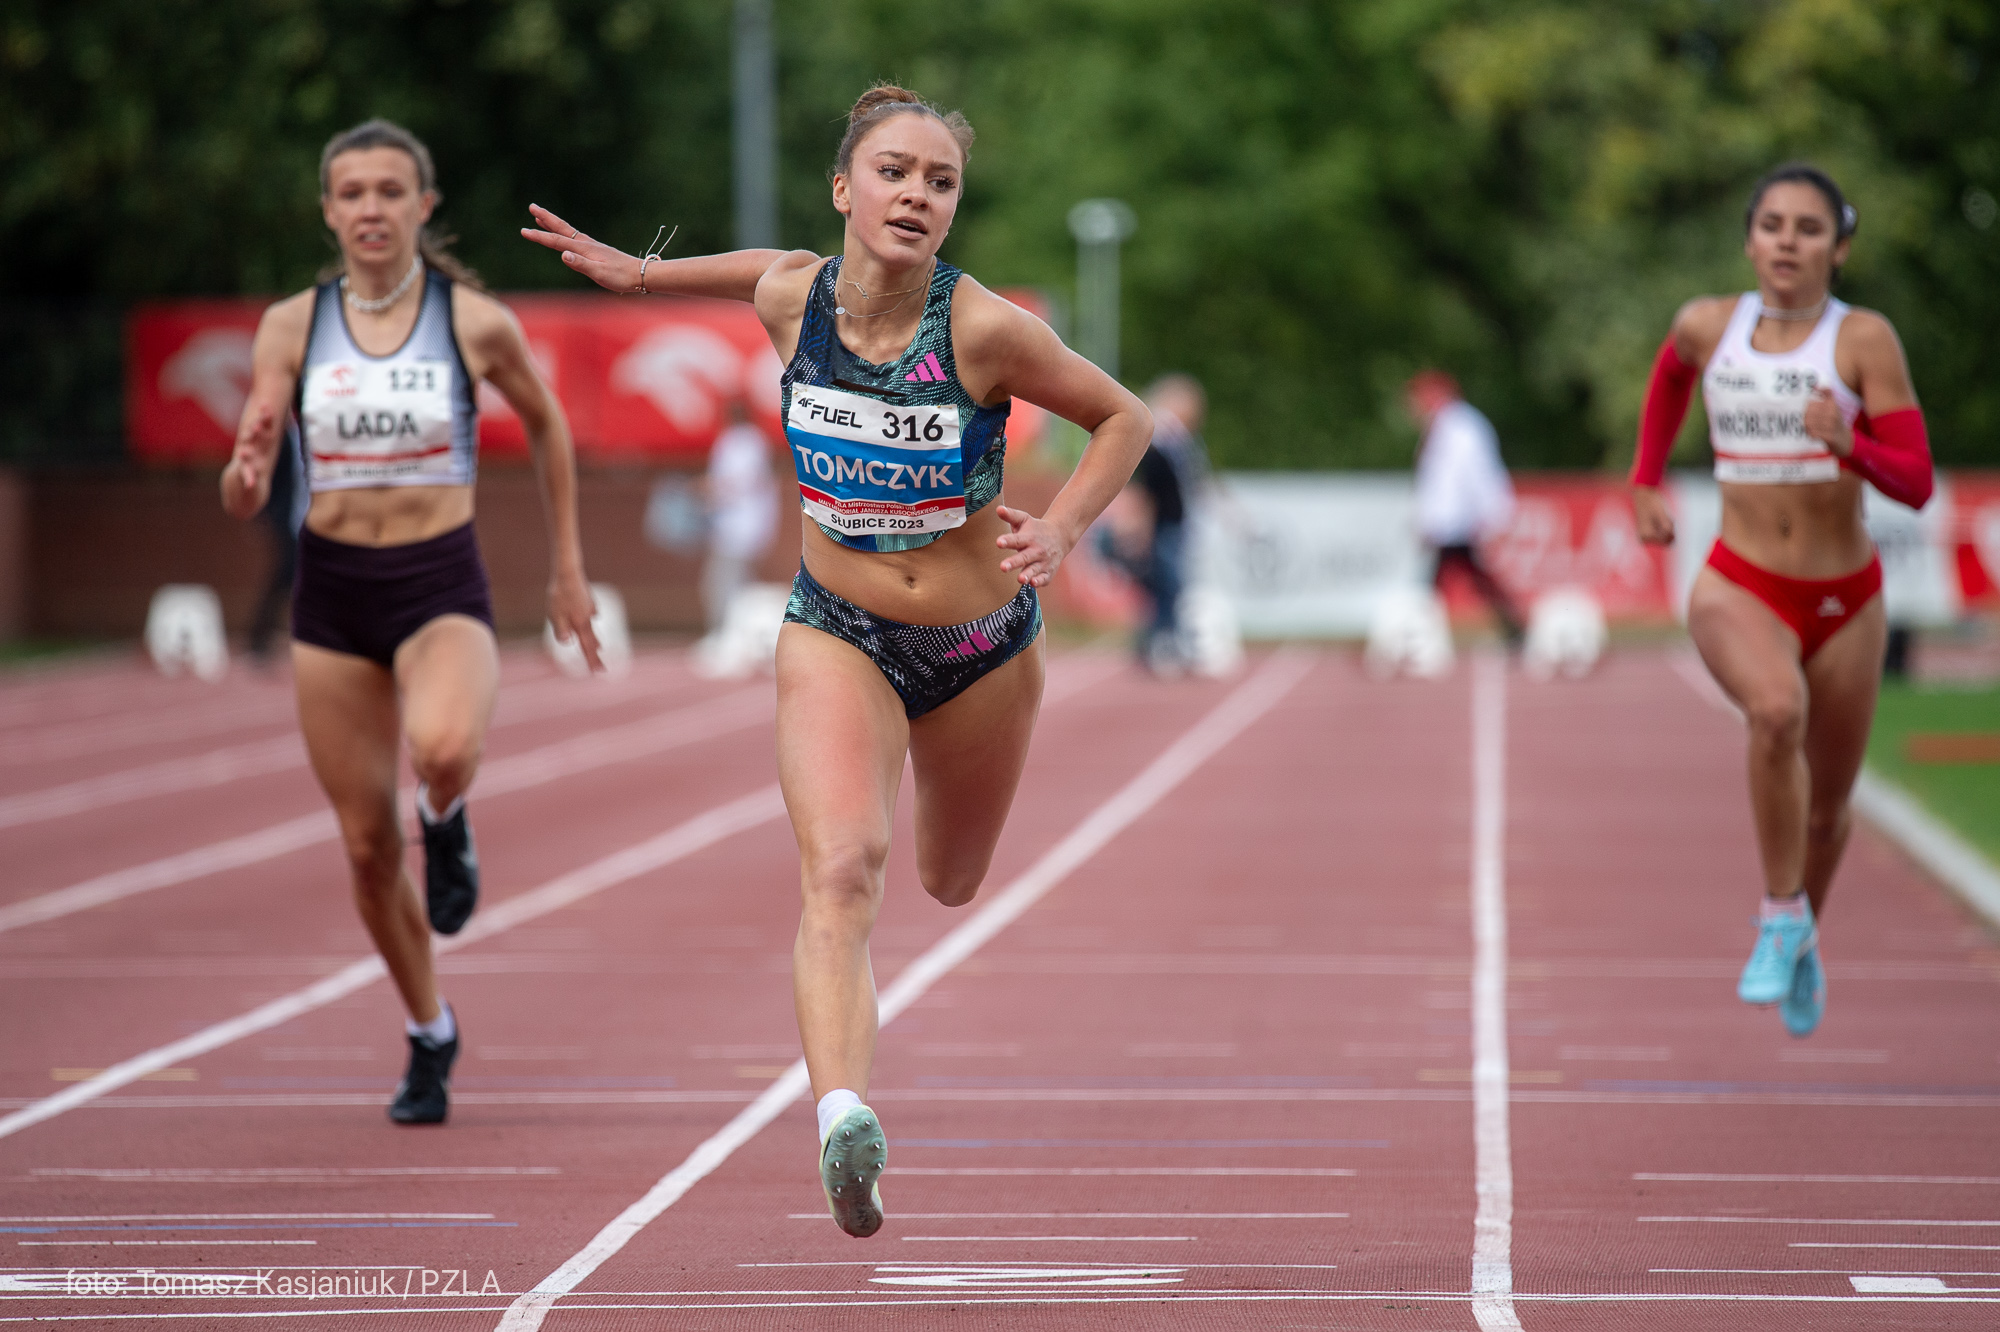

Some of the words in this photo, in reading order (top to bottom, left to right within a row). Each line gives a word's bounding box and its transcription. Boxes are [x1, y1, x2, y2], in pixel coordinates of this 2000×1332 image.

[389, 368, 436, 392] 121
[338, 410, 419, 440] LADA
[810, 403, 863, 429] FUEL
[882, 411, 944, 442] 316
[795, 443, 953, 490] TOMCZYK
[848, 501, 885, 510] Mistrzostwa
[860, 507, 888, 515] JANUSZA
[831, 513, 885, 529] SŁUBICE
[888, 518, 924, 529] 2023
